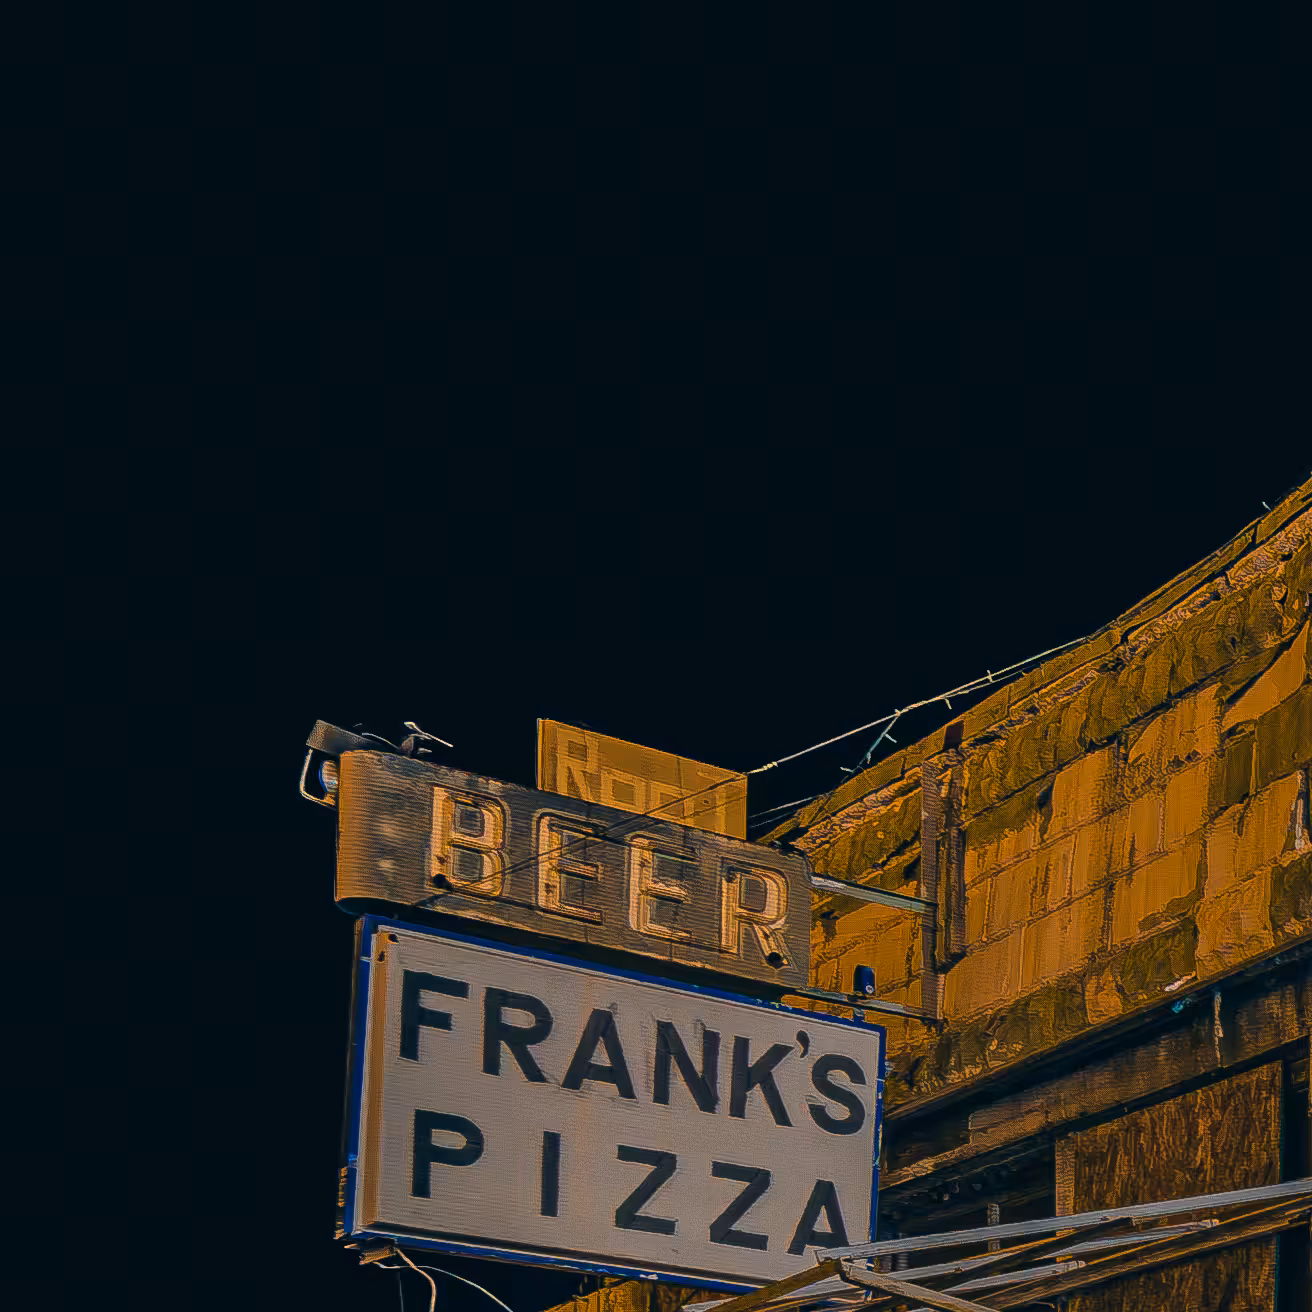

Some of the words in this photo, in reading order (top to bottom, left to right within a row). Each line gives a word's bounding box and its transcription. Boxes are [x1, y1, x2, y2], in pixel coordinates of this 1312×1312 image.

[428, 783, 795, 968] BEER
[399, 968, 867, 1136] FRANK'S
[409, 1108, 850, 1256] PIZZA
